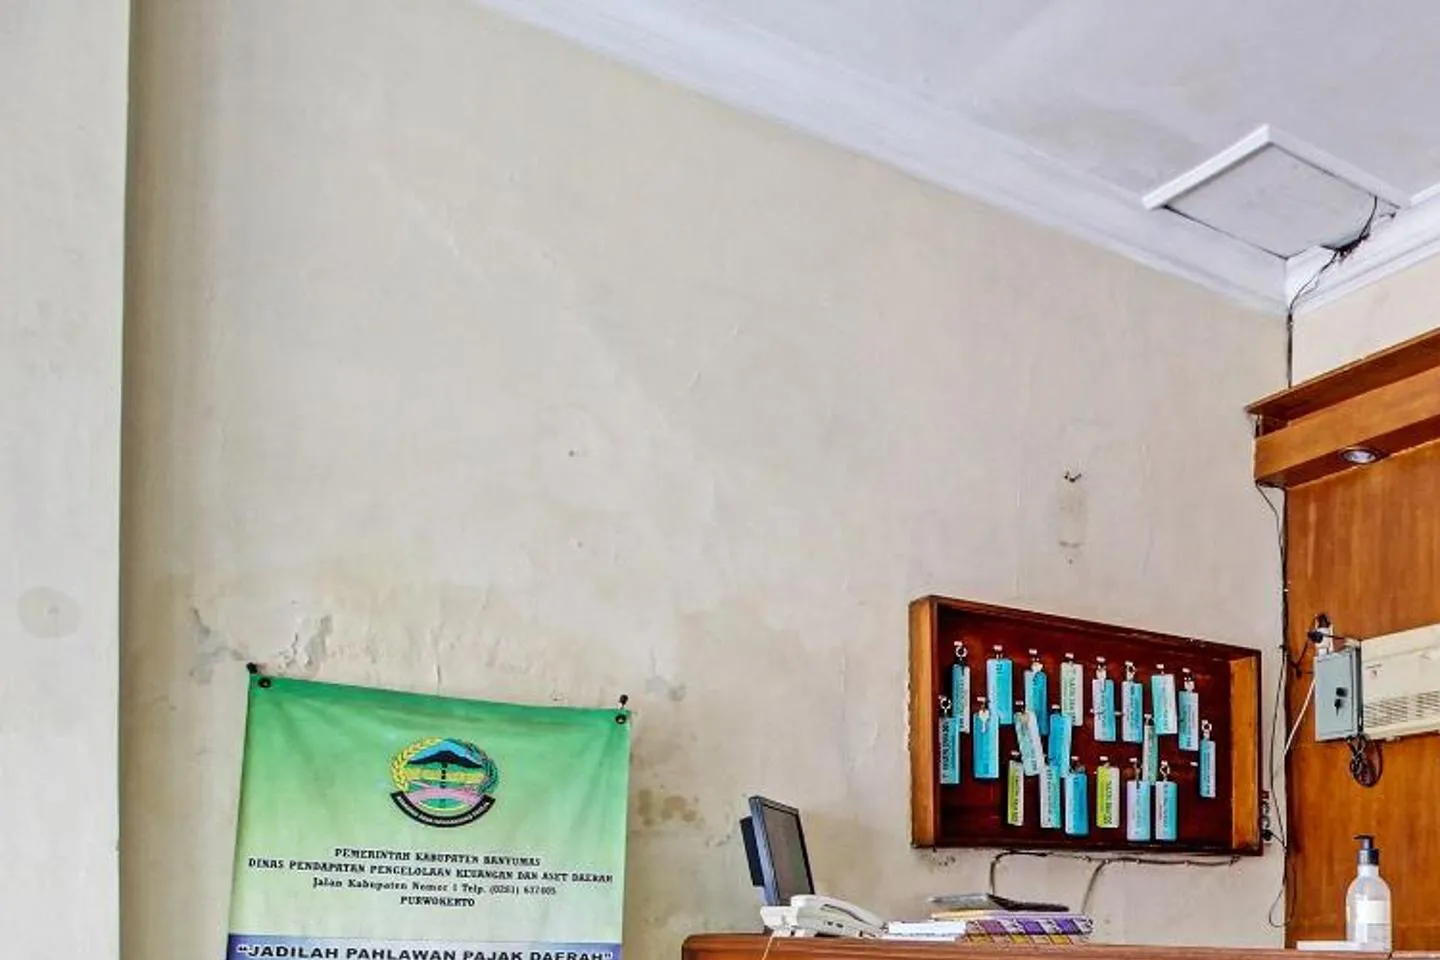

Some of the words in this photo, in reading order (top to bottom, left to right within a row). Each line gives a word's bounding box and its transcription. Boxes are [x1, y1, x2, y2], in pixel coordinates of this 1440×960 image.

[335, 848, 411, 861] PEMERINTAH
[415, 852, 479, 864] KABUPATEN
[483, 855, 541, 867] BANYUMAS
[249, 858, 284, 869] DINAS
[289, 861, 365, 874] PENDAPATAN
[370, 865, 451, 877] PENGELOLAAN
[456, 868, 513, 880] KEUANGAN
[517, 871, 538, 880] DAN
[541, 872, 568, 882] ASET
[571, 874, 613, 883] DAERAH
[313, 877, 343, 888] Jalan
[348, 879, 408, 891] Kabupaten
[400, 896, 475, 908] PURWOKERTO
[346, 948, 456, 960] PAHLAWAN
